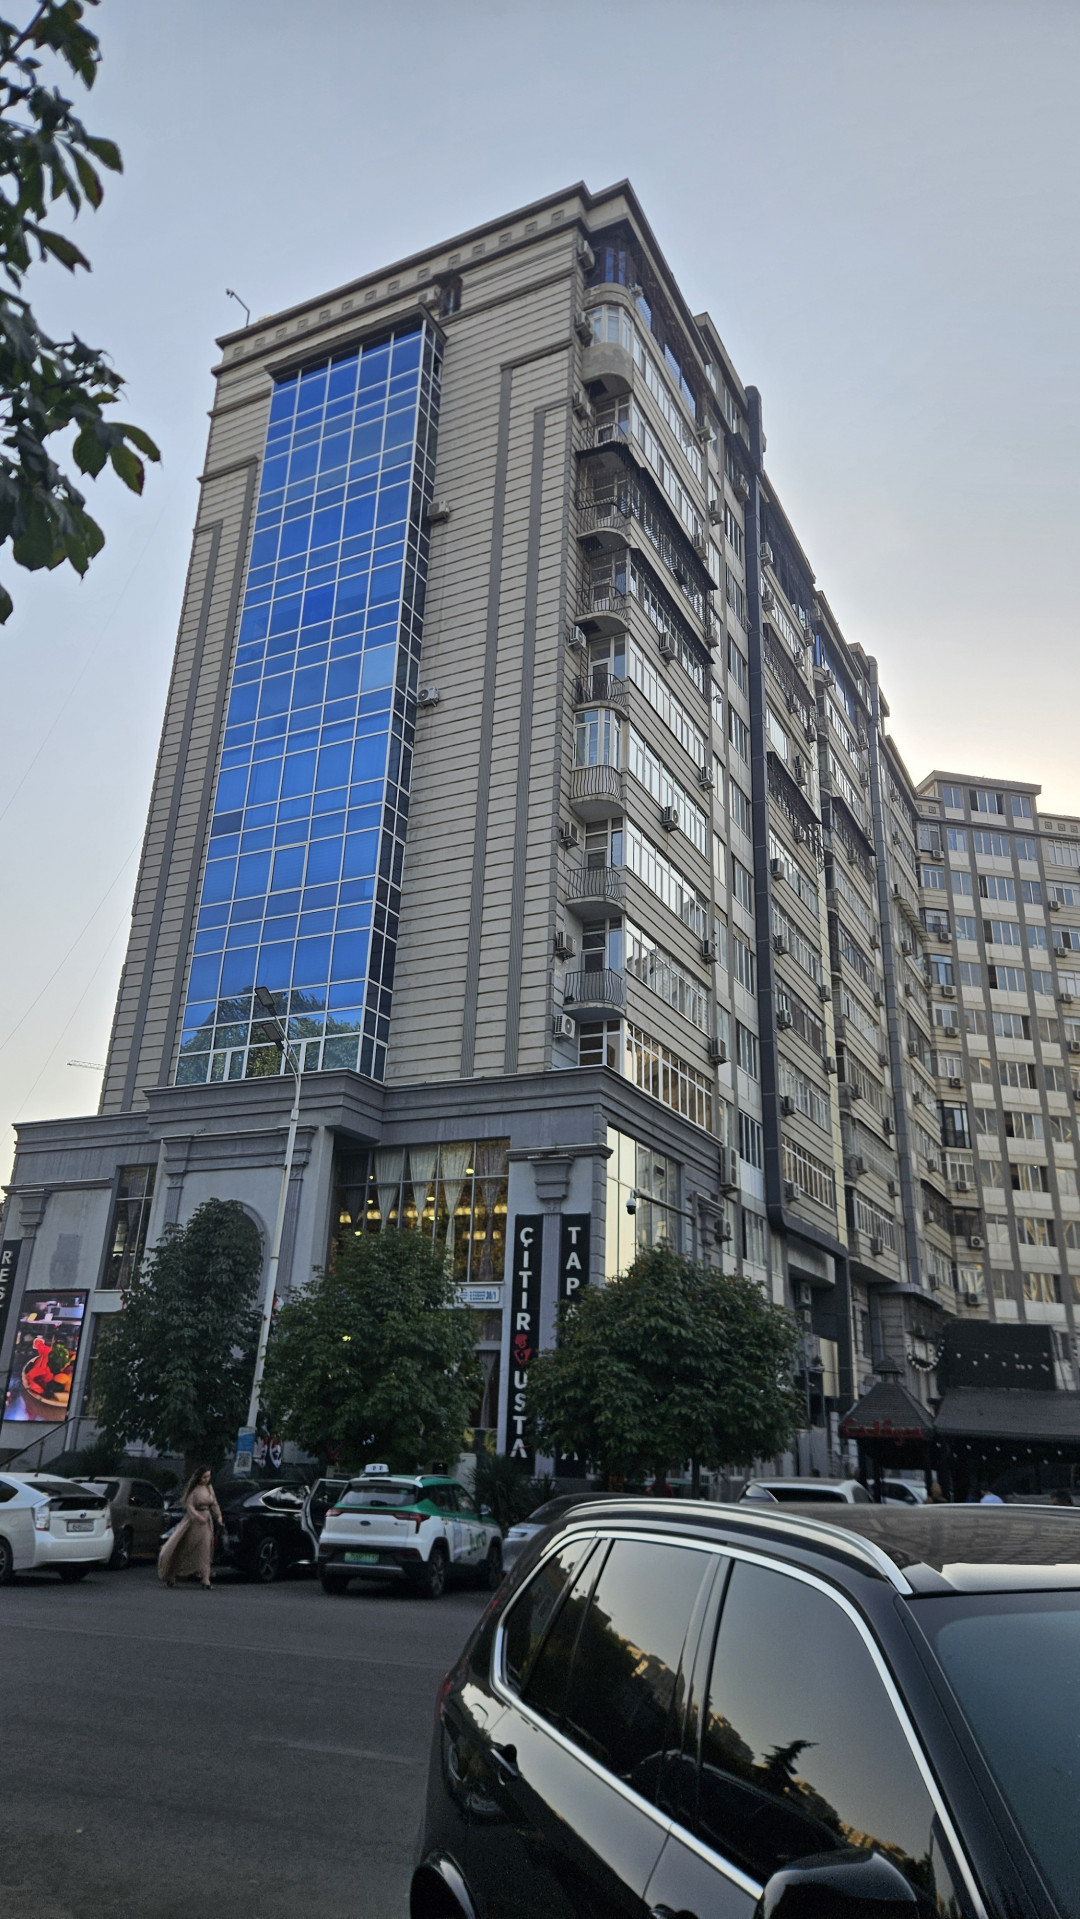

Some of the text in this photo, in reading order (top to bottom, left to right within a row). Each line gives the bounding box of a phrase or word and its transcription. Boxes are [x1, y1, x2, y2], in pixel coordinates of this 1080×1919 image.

[0, 1250, 13, 1308] RES
[511, 1227, 534, 1459] ÇITIR USTA
